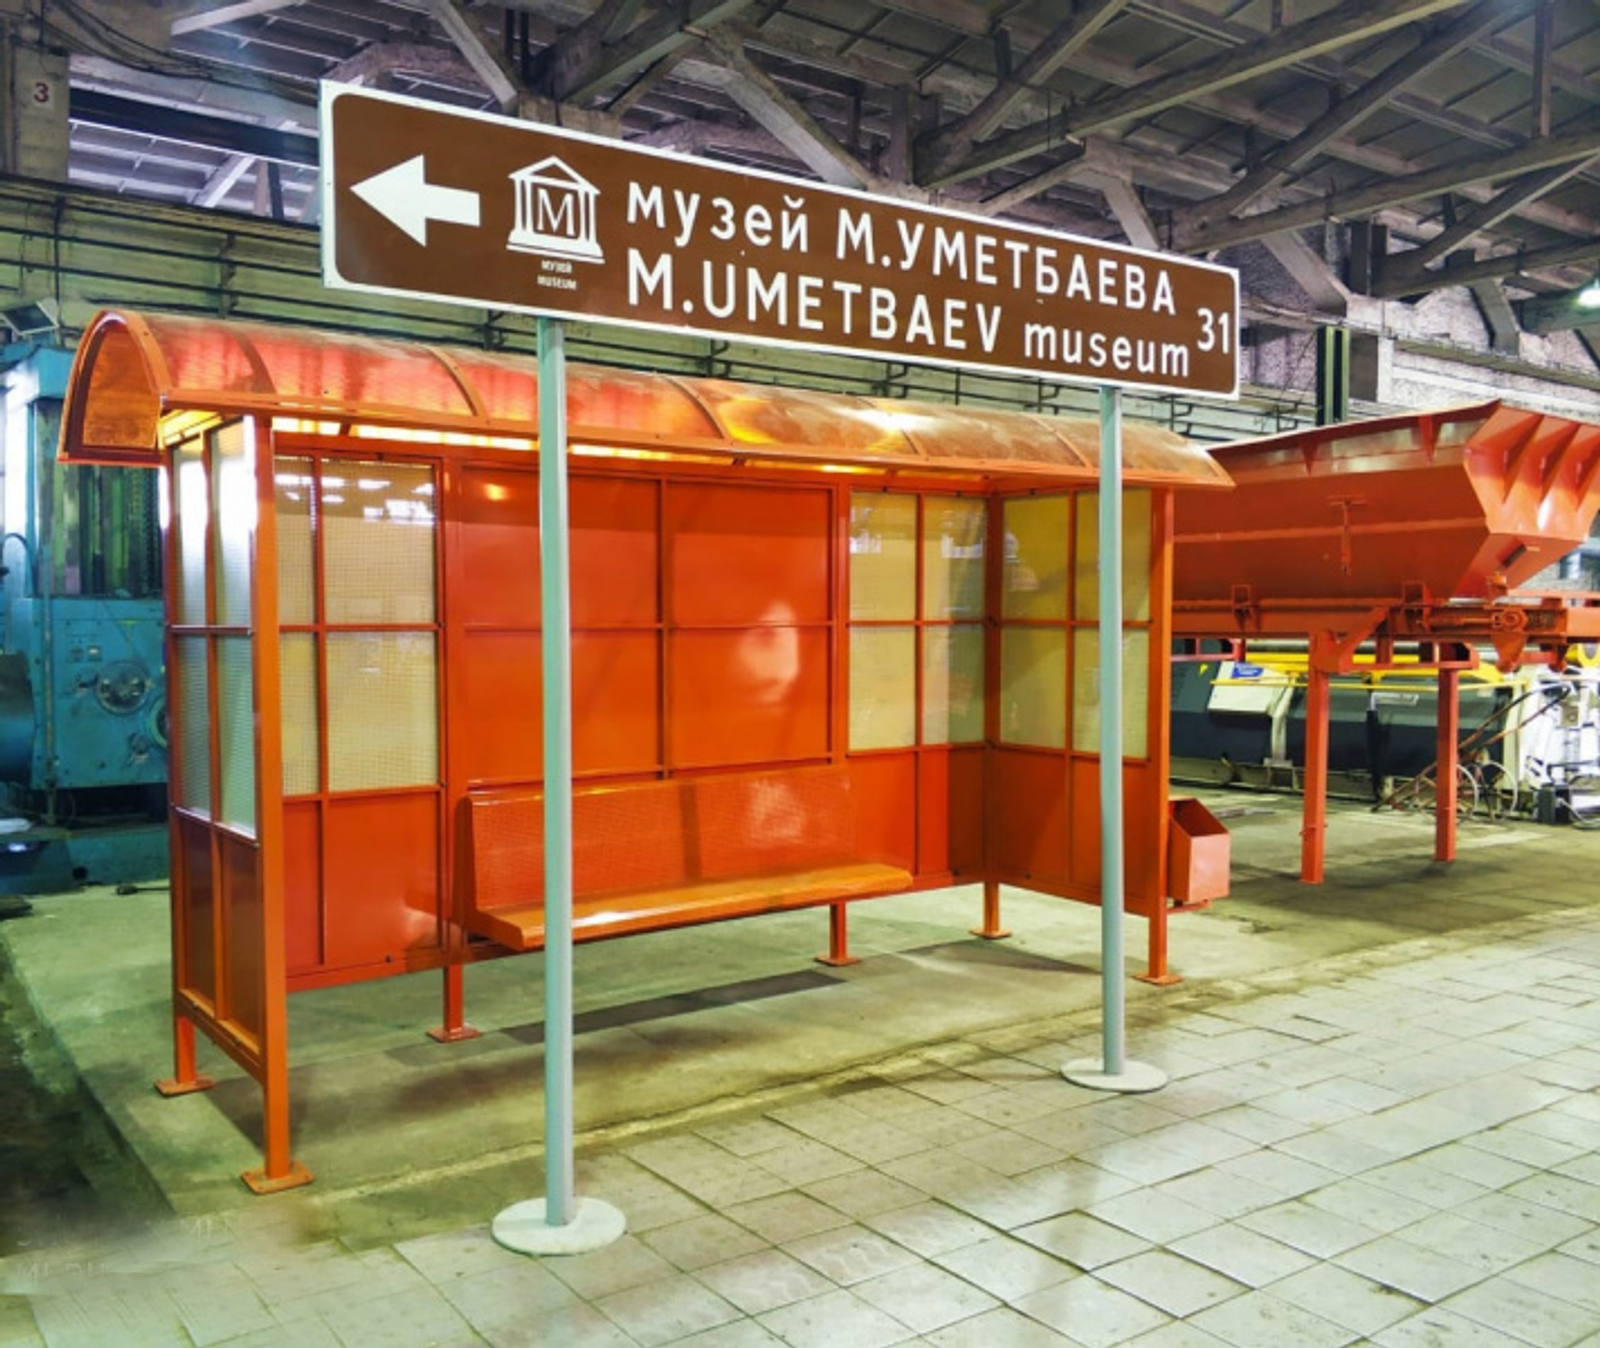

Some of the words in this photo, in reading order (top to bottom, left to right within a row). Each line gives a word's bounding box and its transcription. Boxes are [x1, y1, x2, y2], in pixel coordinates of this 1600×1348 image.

[34, 82, 49, 103] 3
[627, 181, 808, 253] музей
[836, 208, 1176, 316] М.УМЕТБАЕВА
[627, 247, 1002, 353] M.UMETBAEV
[1024, 323, 1189, 378] museum
[1197, 307, 1230, 354] 31
